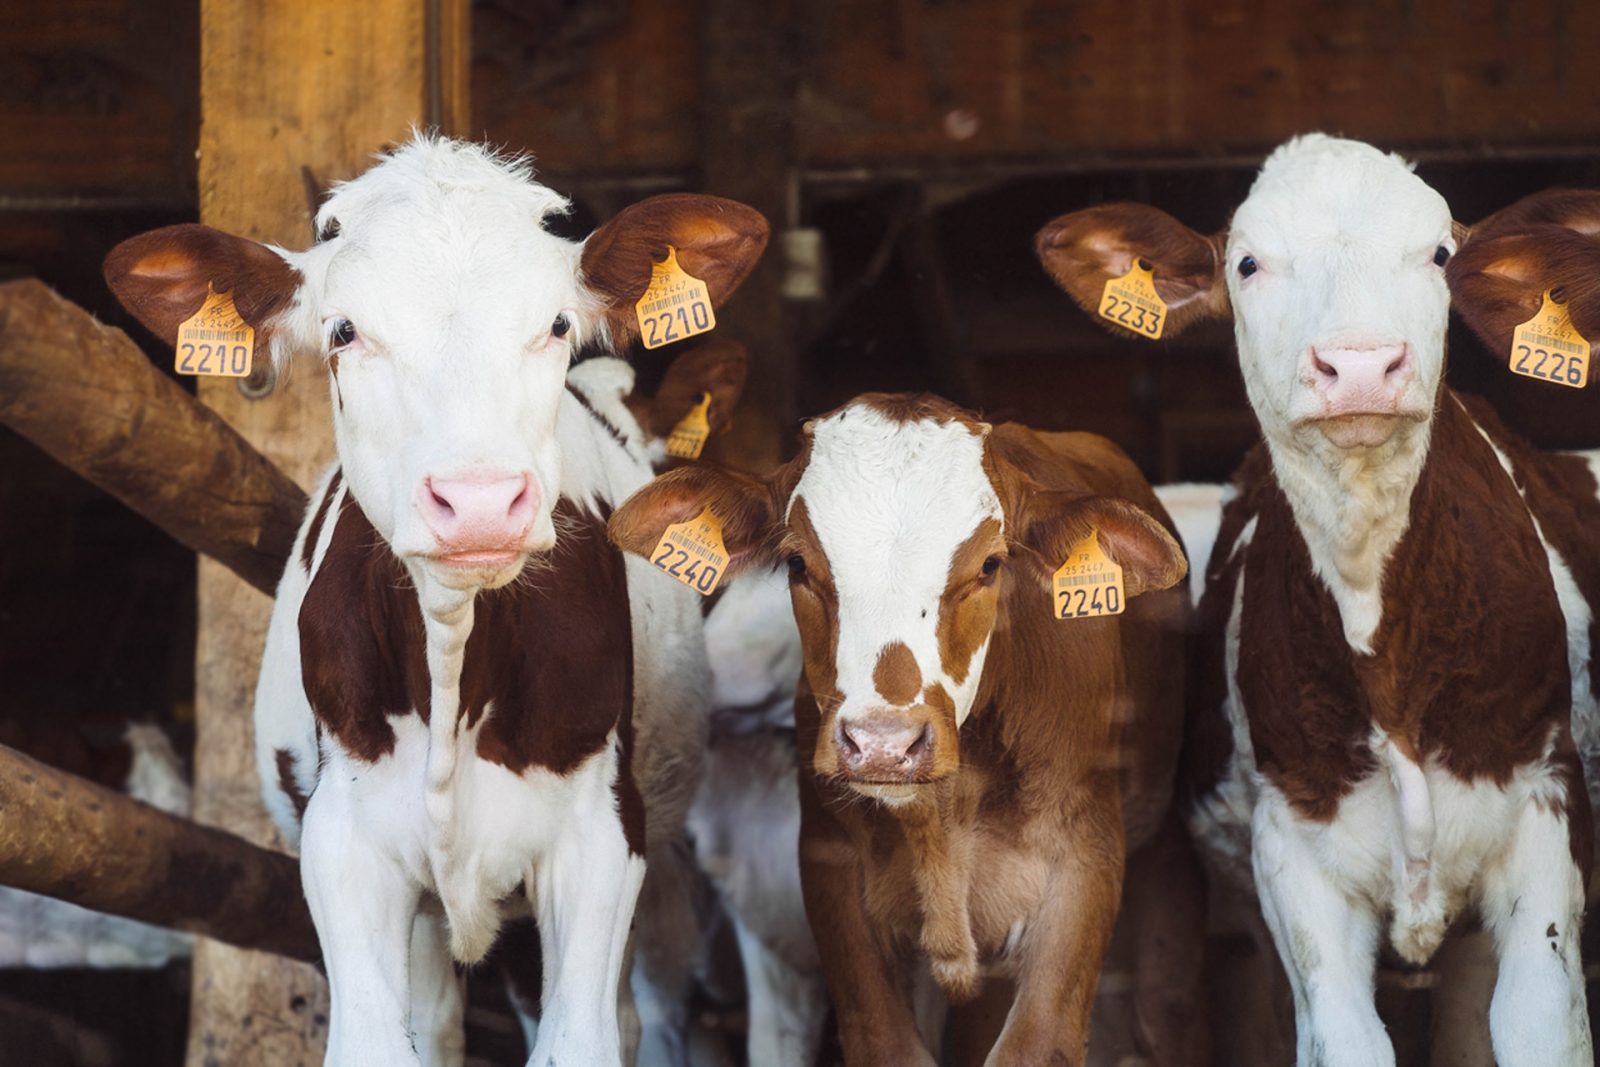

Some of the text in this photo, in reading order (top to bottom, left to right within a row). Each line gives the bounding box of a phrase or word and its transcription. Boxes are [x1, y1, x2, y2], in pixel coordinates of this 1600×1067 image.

[659, 275, 671, 284] FR
[210, 307, 223, 316] FR
[643, 301, 709, 346] 2210
[1103, 295, 1161, 334] 2233
[180, 343, 247, 374] 2210
[1515, 344, 1582, 385] 2226
[655, 542, 717, 592] 2240
[1058, 585, 1119, 618] 2240
